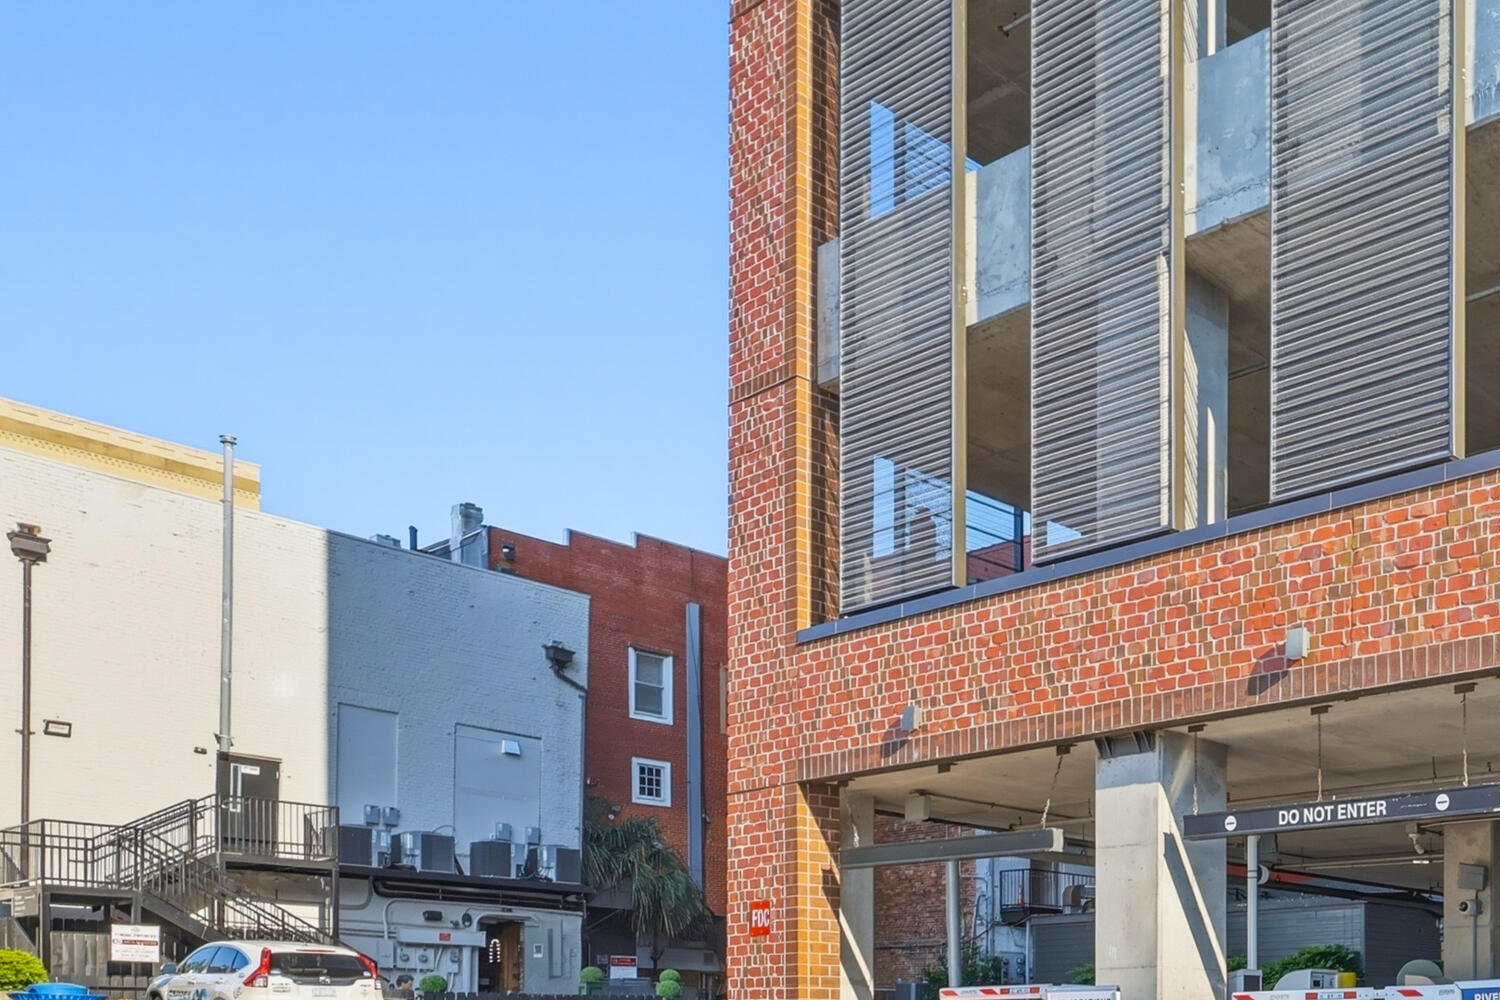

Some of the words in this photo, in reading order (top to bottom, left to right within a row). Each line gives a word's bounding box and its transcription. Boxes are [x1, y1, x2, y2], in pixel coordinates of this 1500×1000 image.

[1278, 804, 1300, 825] DO
[1303, 805, 1335, 823] NOT
[1337, 800, 1387, 820] ENTER
[752, 908, 770, 928] FDC
